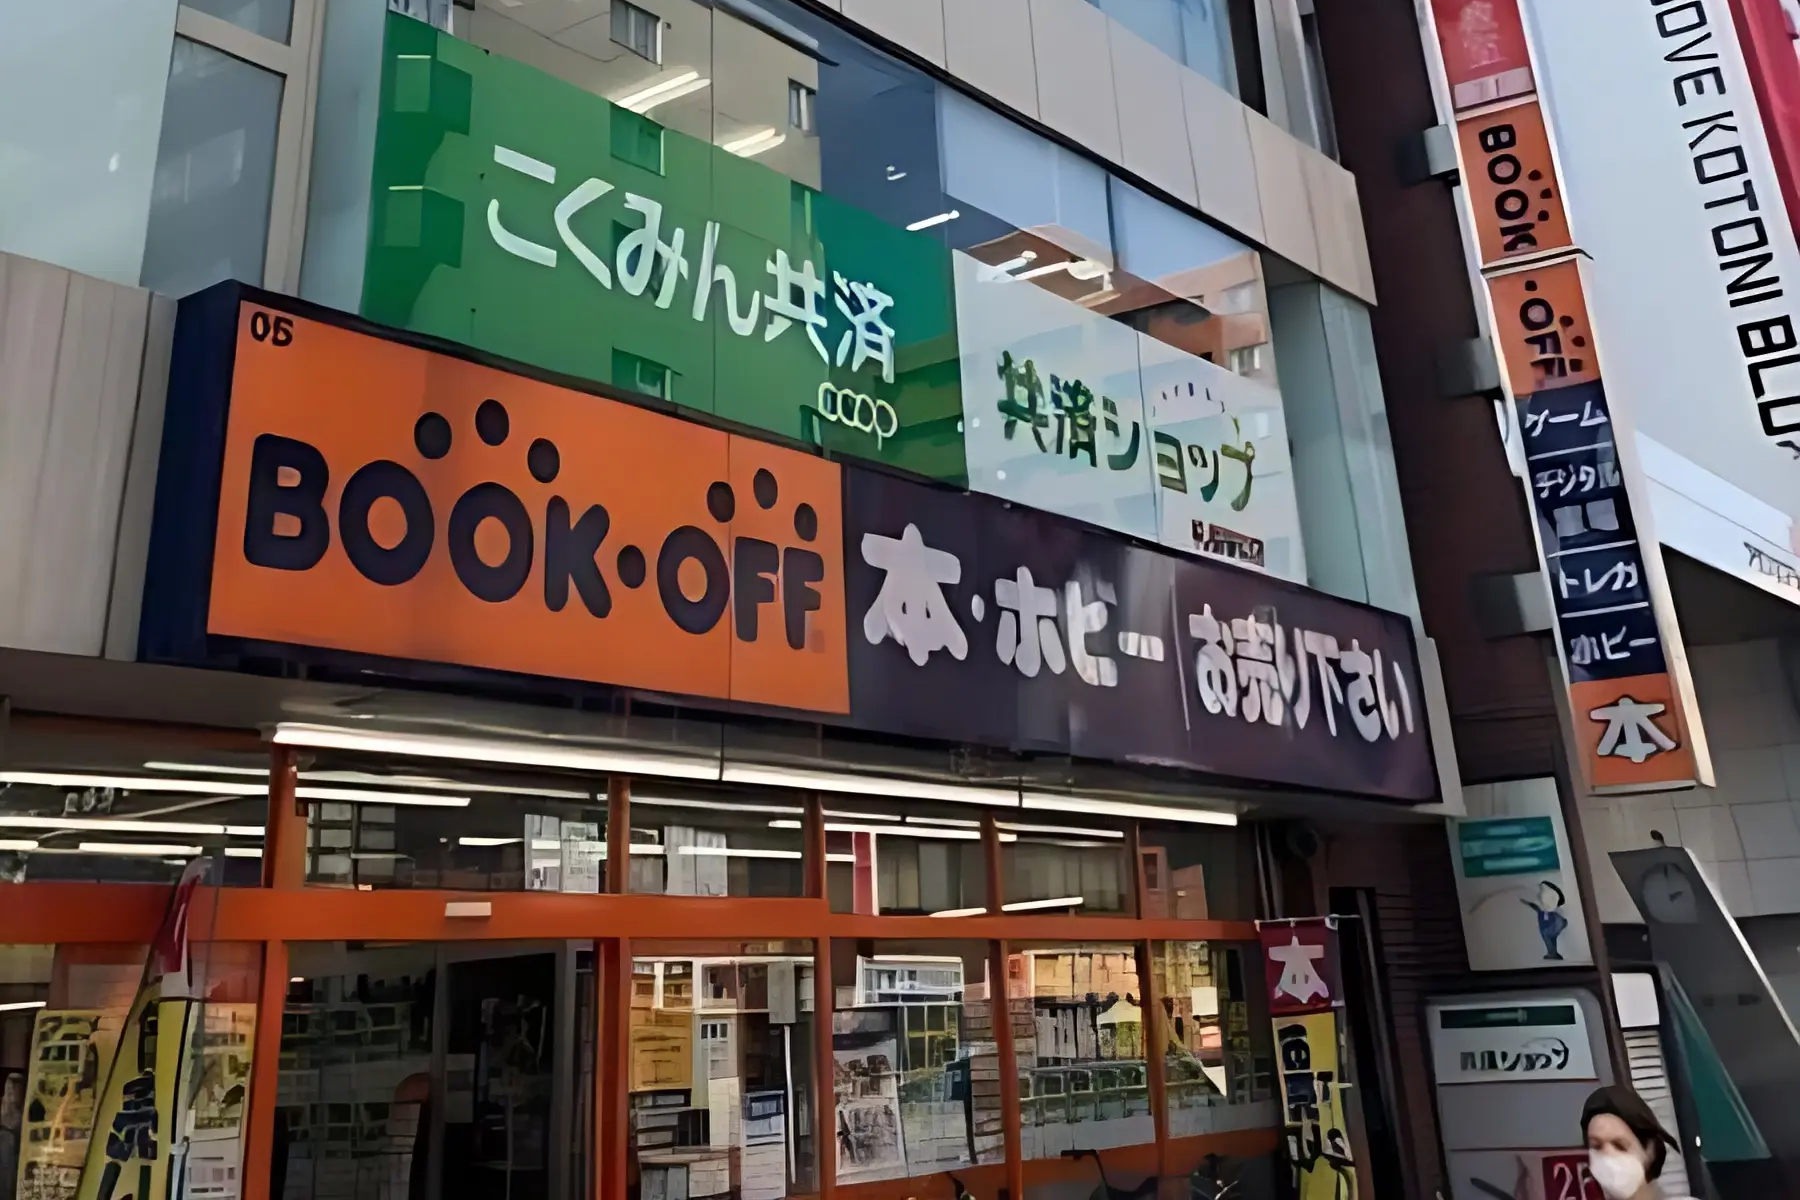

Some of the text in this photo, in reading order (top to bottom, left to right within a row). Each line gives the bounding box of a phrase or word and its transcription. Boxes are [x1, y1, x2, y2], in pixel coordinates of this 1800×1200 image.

[1479, 123, 1538, 253] BOOK
[1682, 111, 1783, 308] KOTONI
[487, 145, 896, 384] こくみん共済
[1188, 602, 1415, 743] お売り下さい
[1590, 696, 1677, 763] 本
[1268, 935, 1330, 1004] 本
